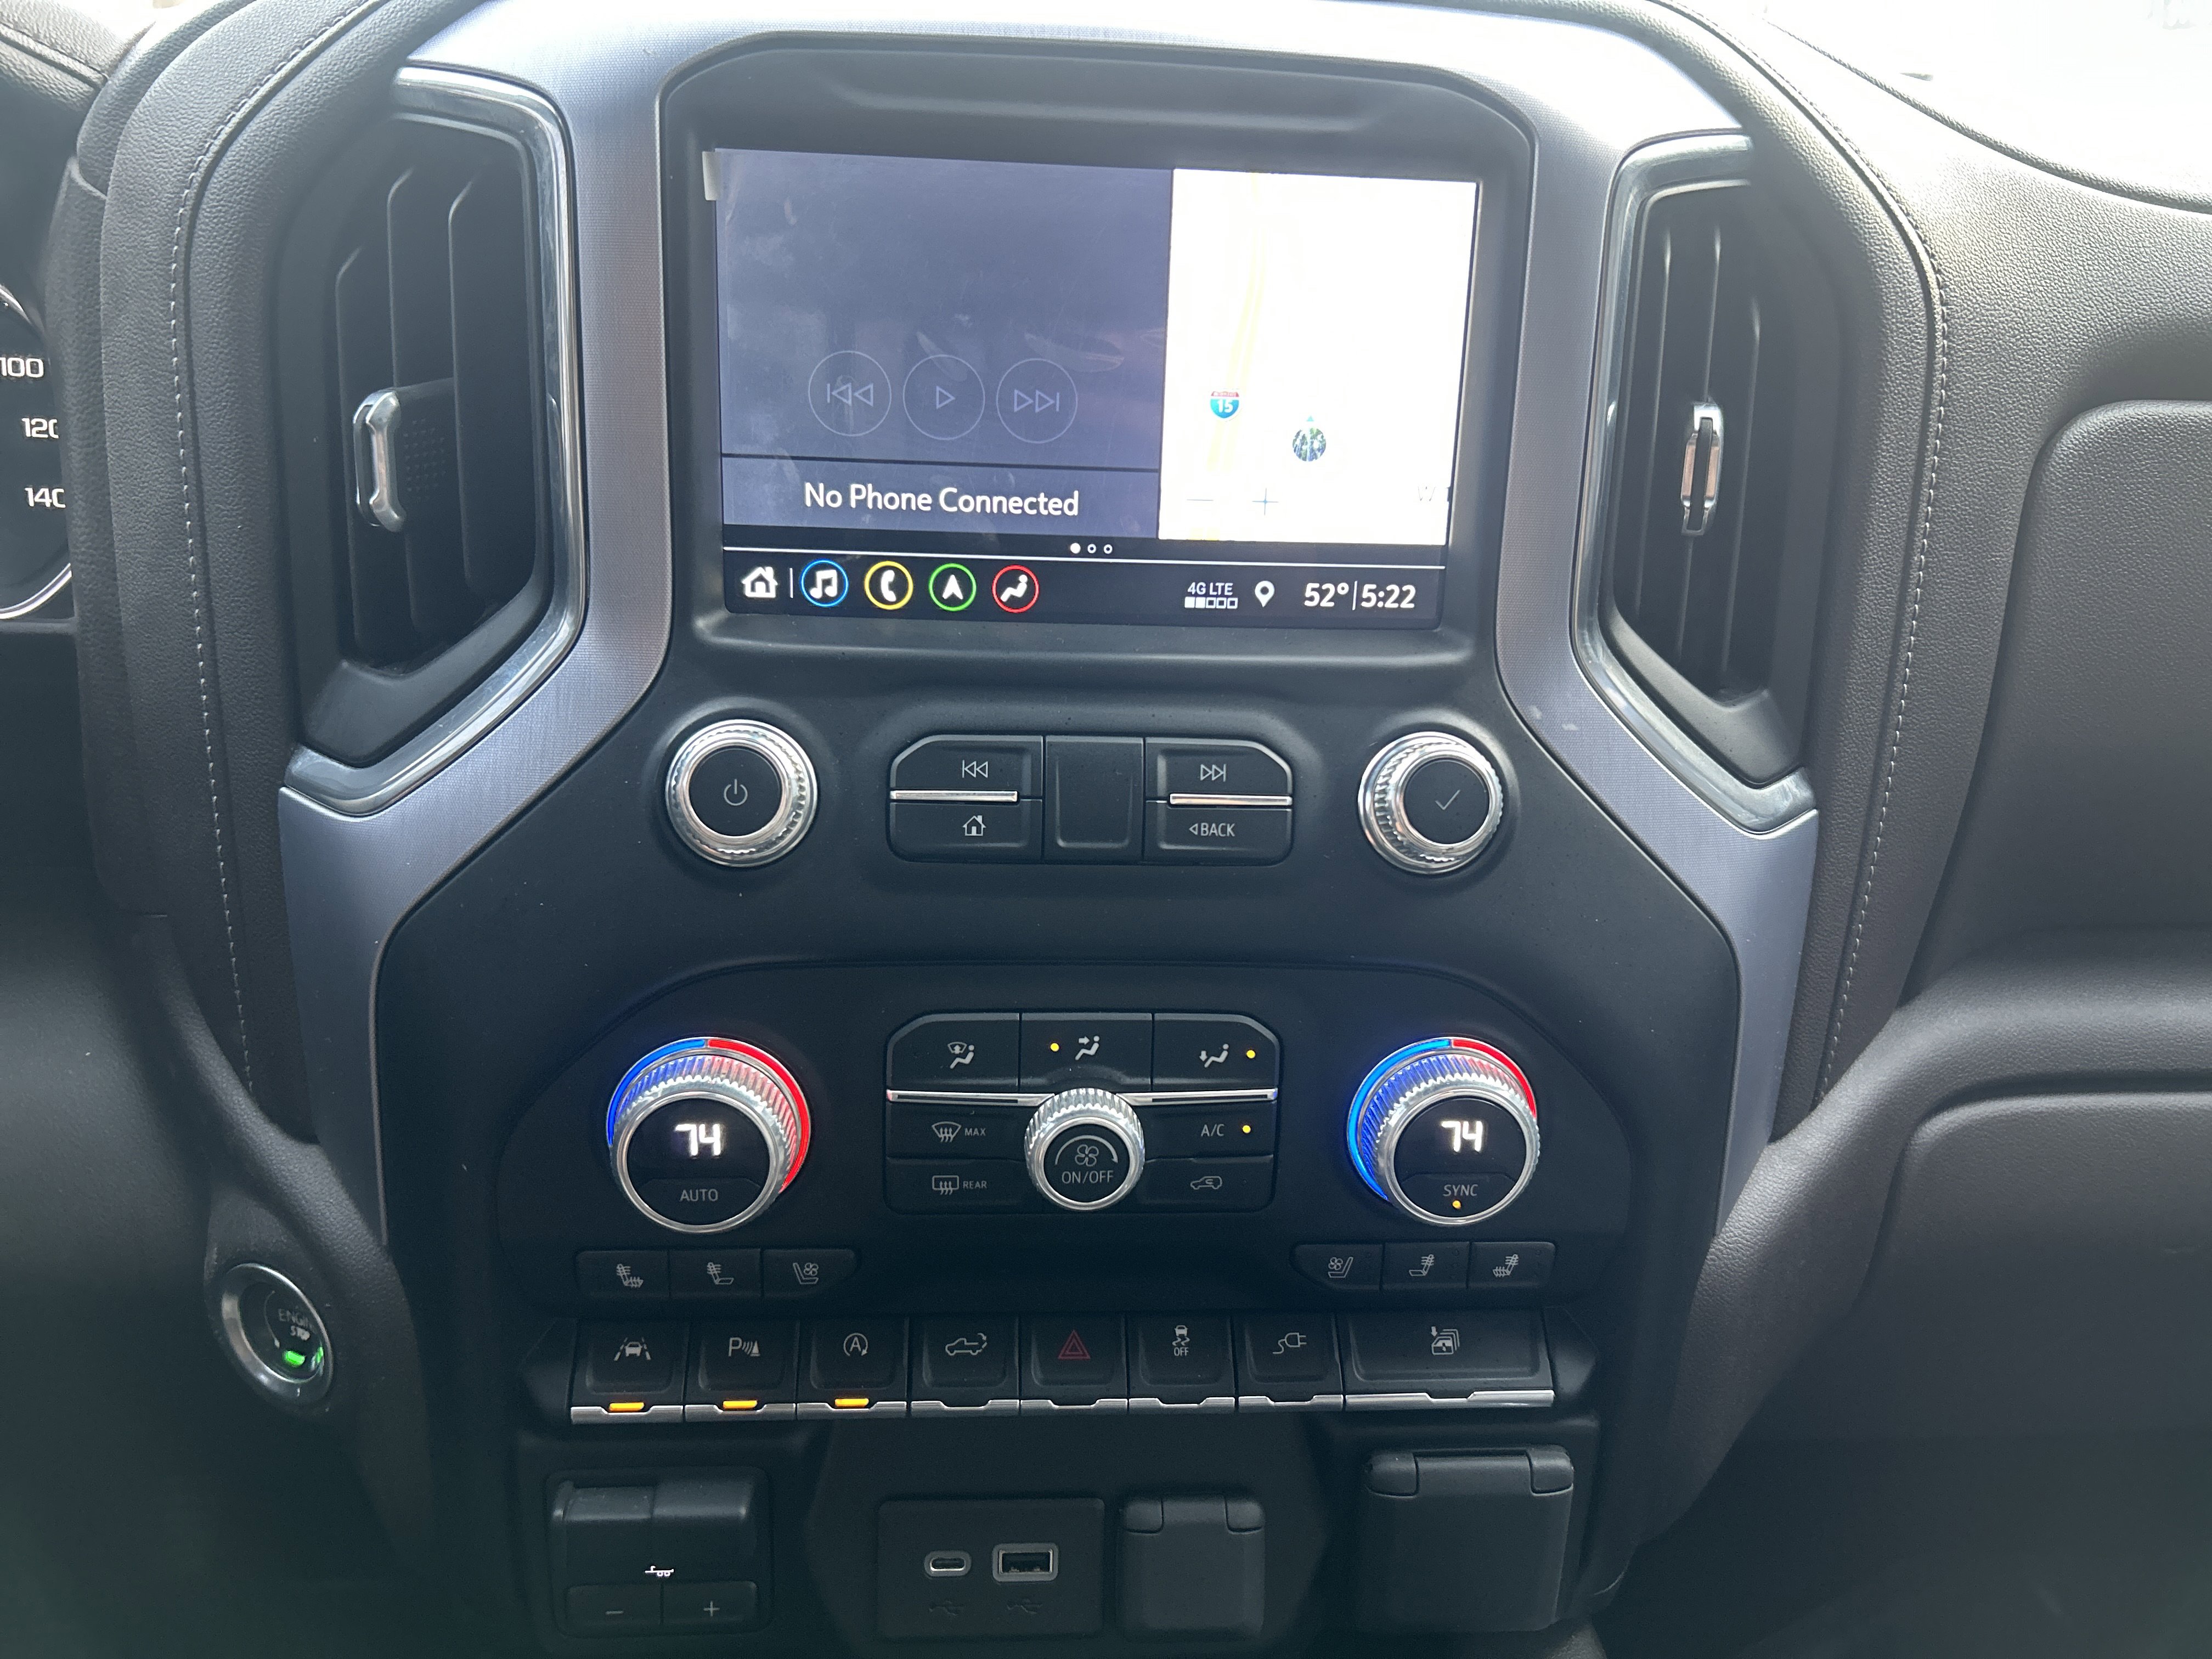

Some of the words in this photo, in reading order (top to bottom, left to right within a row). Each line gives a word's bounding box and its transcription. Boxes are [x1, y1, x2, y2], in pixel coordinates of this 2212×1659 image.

[0, 358, 44, 377] 100
[1217, 399, 1233, 413] 15
[805, 482, 842, 507] No
[850, 483, 932, 511] Phone
[939, 488, 1079, 516] Connected
[1187, 582, 1206, 595] 4G
[1209, 582, 1233, 596] LTE
[1361, 584, 1417, 608] 5:22
[1200, 822, 1235, 837] BACK
[964, 1127, 986, 1137] MAX
[1200, 1124, 1224, 1137] A/C
[1441, 1121, 1483, 1152] 74
[674, 1124, 721, 1156] 74
[963, 1180, 987, 1189] REAR
[1062, 1171, 1114, 1184] ON/OFF
[680, 1188, 718, 1202] AUTO
[1443, 1184, 1478, 1197] SYNC
[1173, 1347, 1189, 1356] OFF
